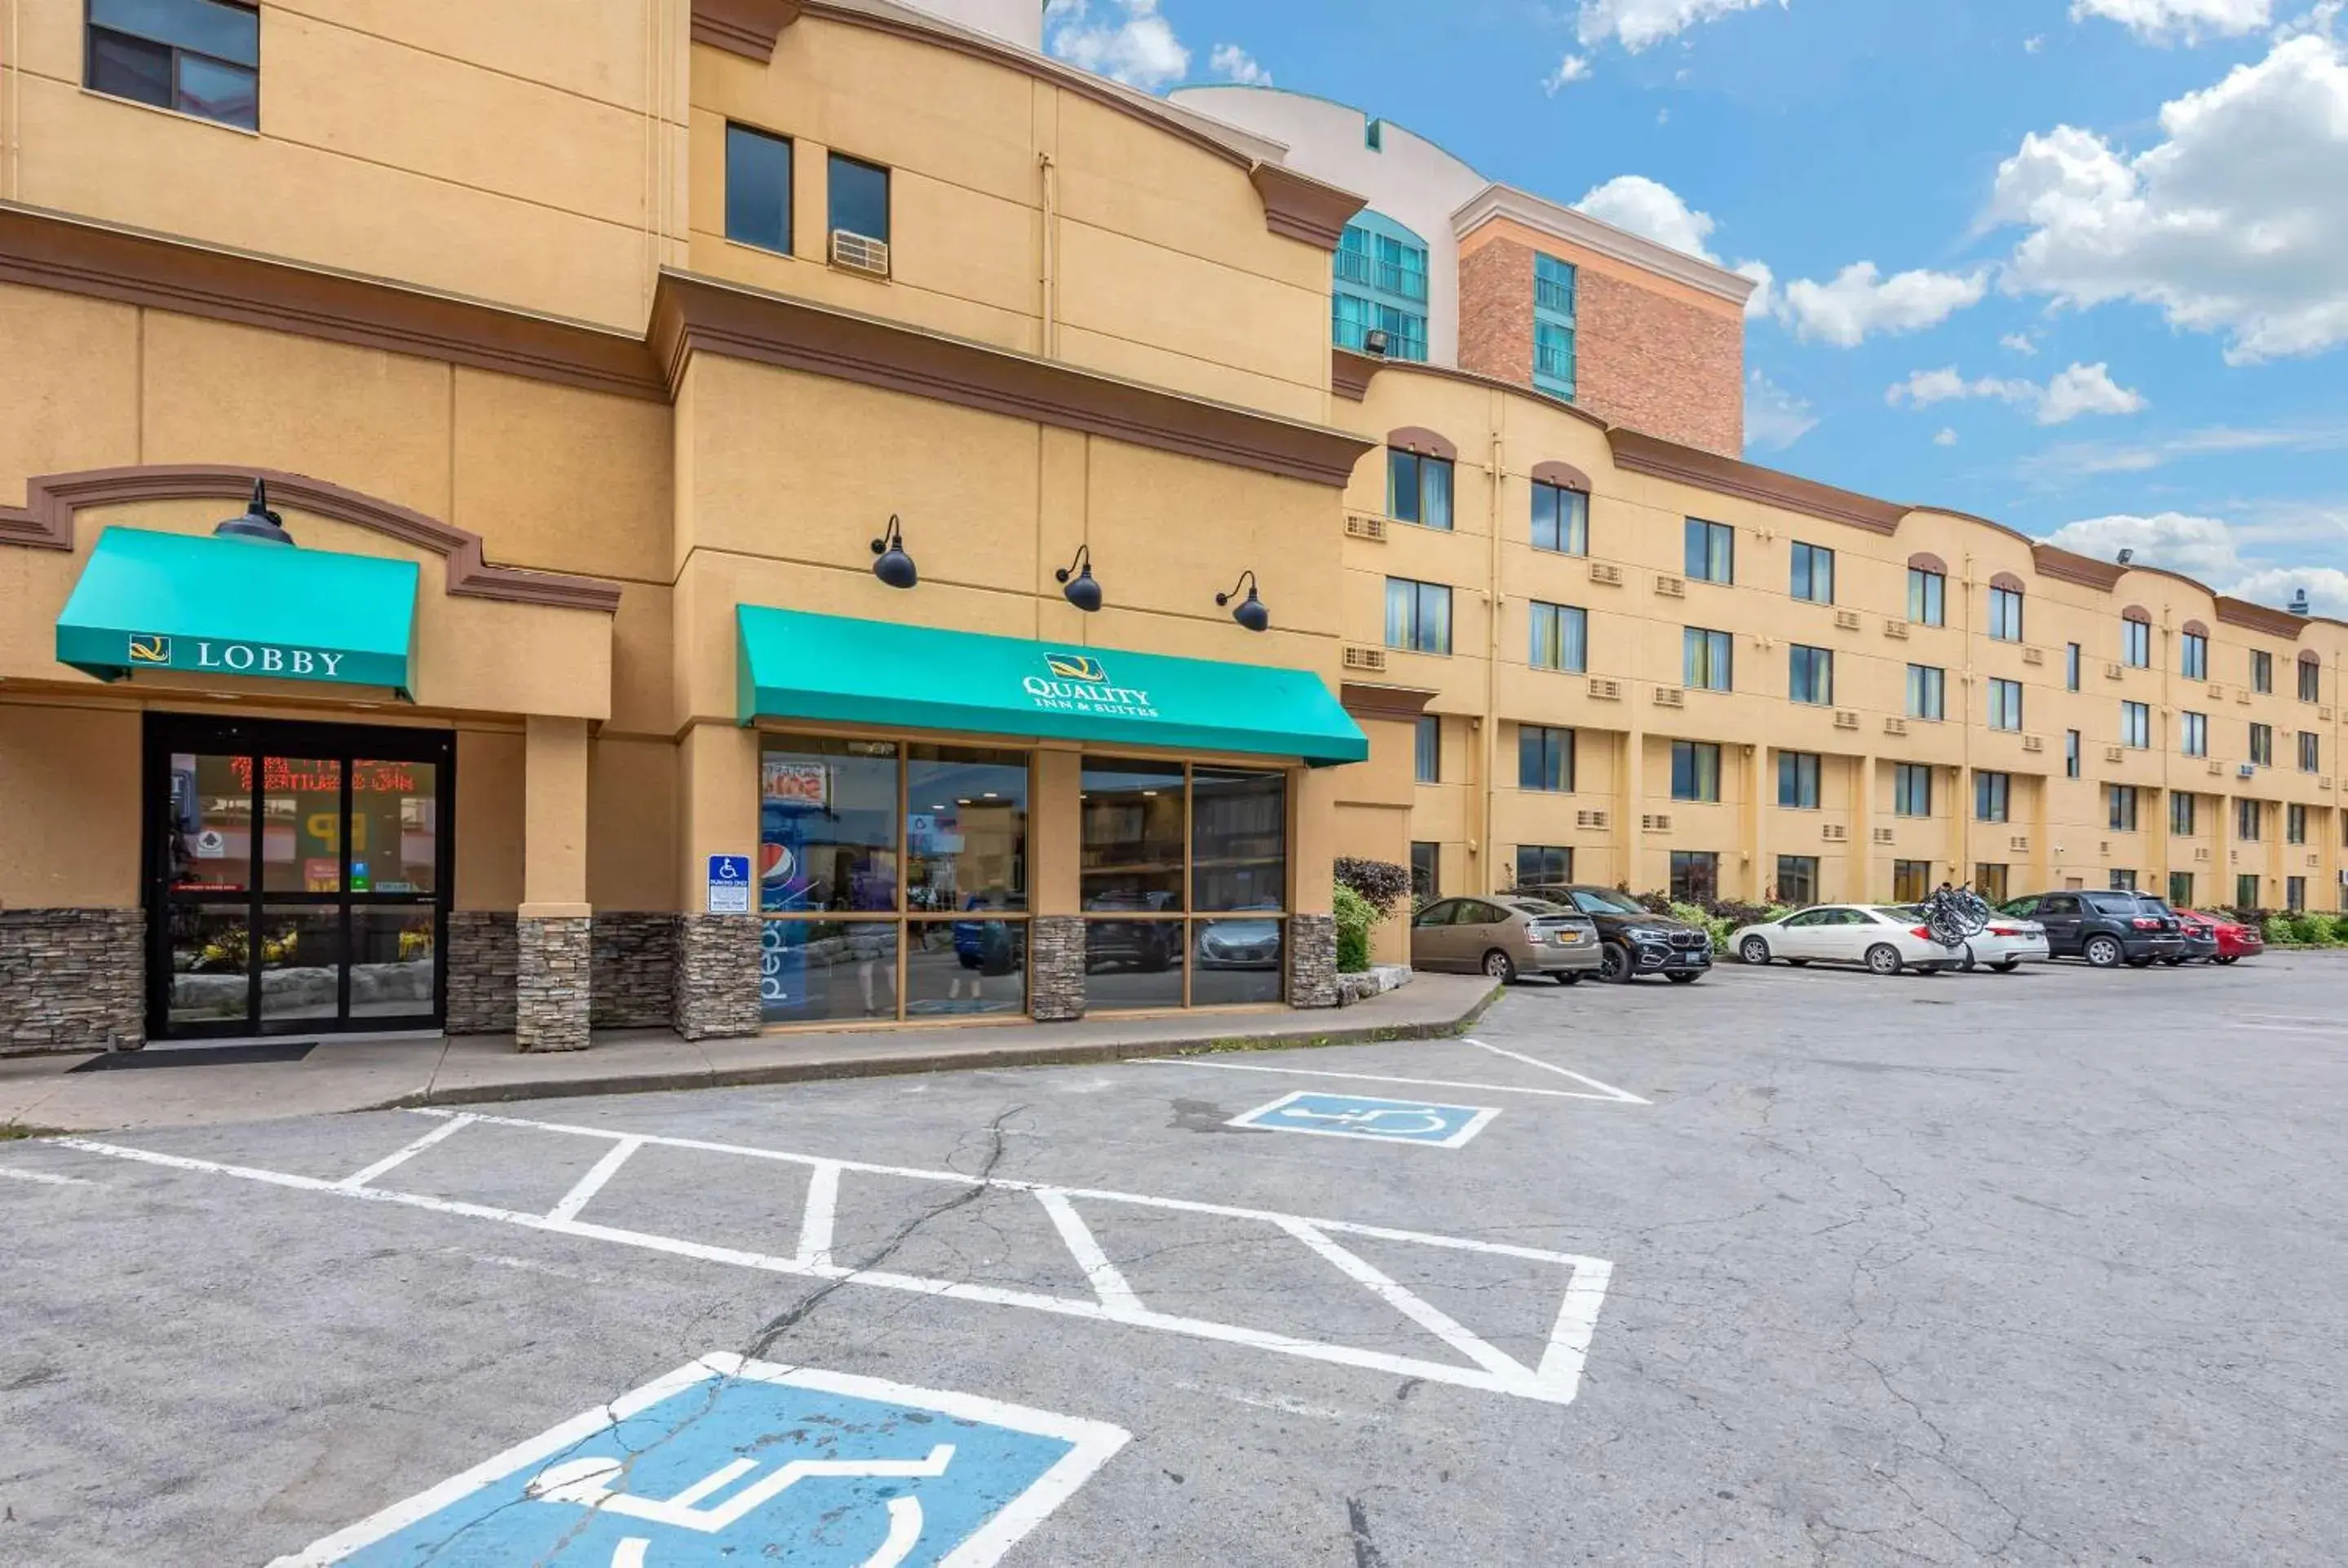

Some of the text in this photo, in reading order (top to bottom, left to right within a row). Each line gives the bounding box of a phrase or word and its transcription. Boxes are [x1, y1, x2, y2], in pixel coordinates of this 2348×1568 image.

[197, 642, 344, 677] LOBBY
[1023, 676, 1151, 705] QUALITY
[1033, 698, 1159, 718] INN & SUITES
